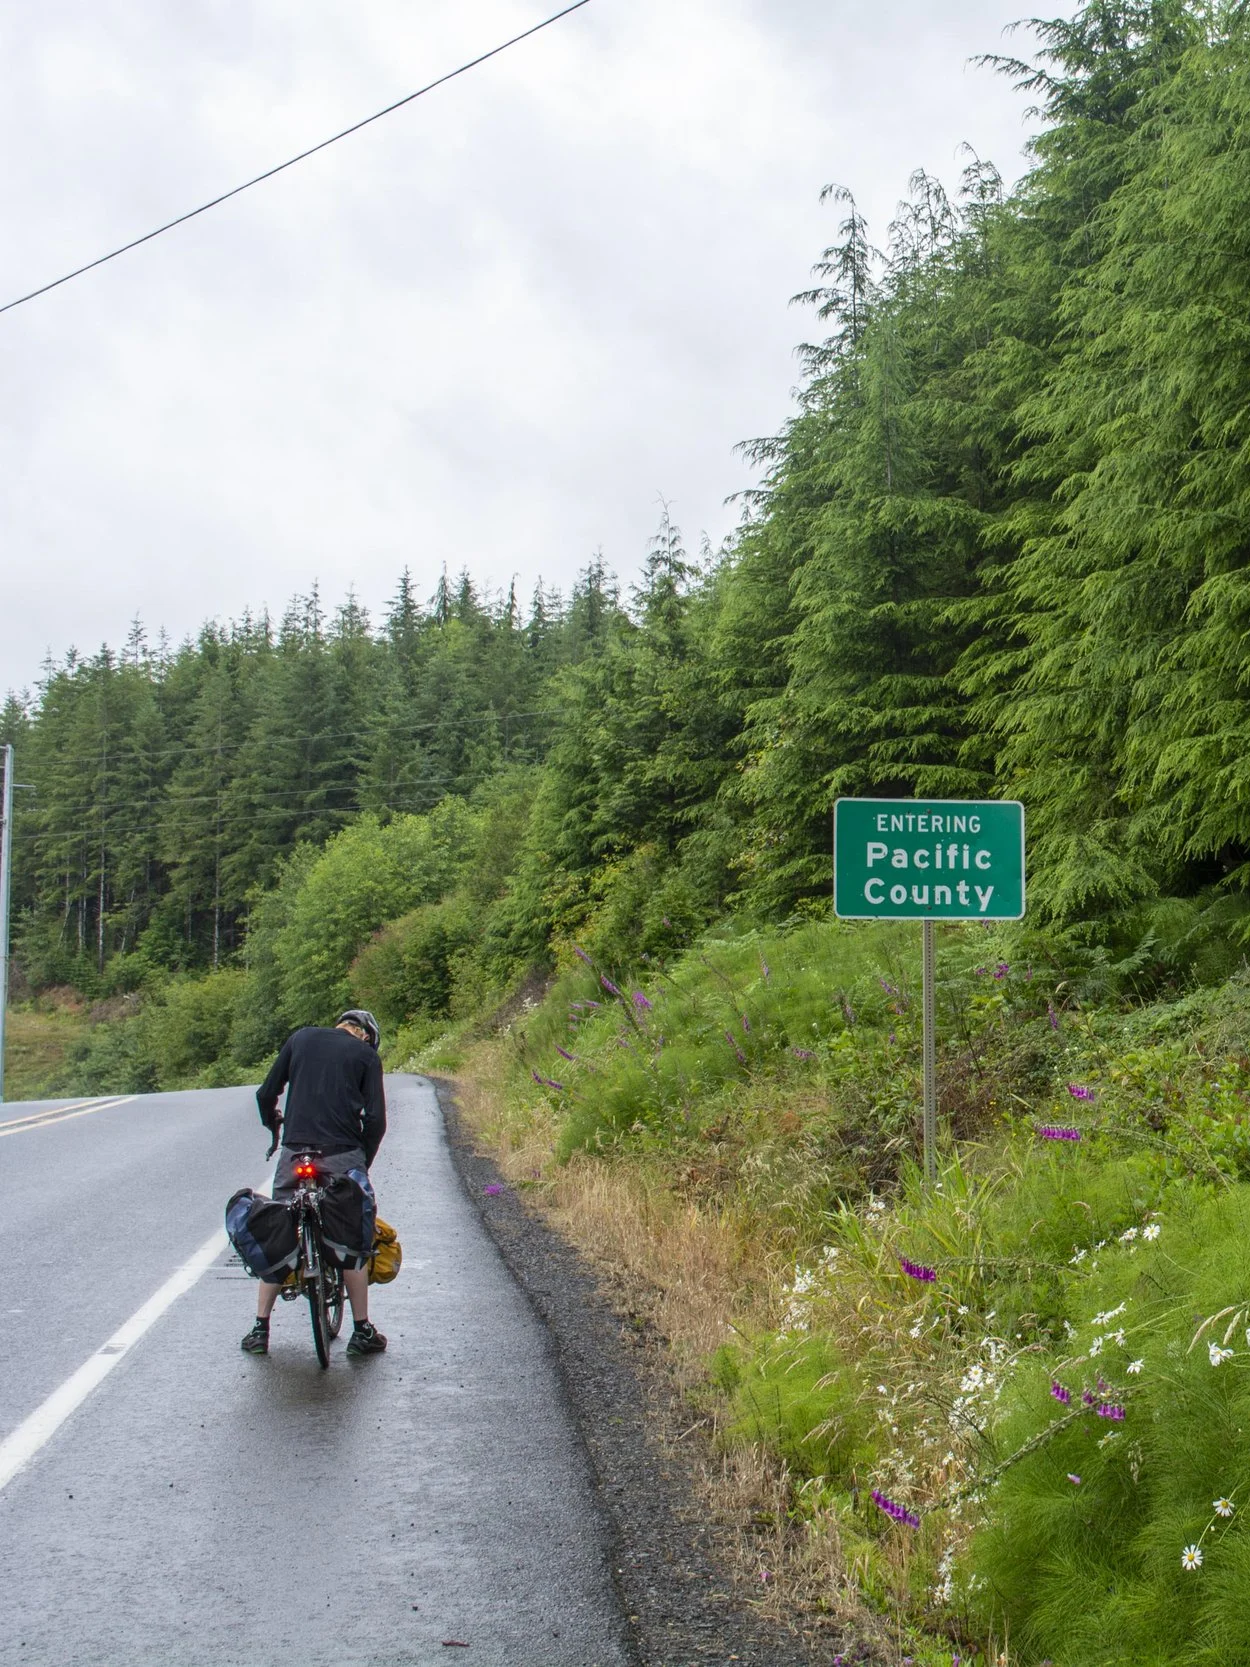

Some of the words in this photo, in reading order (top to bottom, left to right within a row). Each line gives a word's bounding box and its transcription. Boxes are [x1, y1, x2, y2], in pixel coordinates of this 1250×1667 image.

[876, 813, 982, 834] ENTERING
[866, 841, 992, 870] Pacific
[863, 877, 995, 912] County
